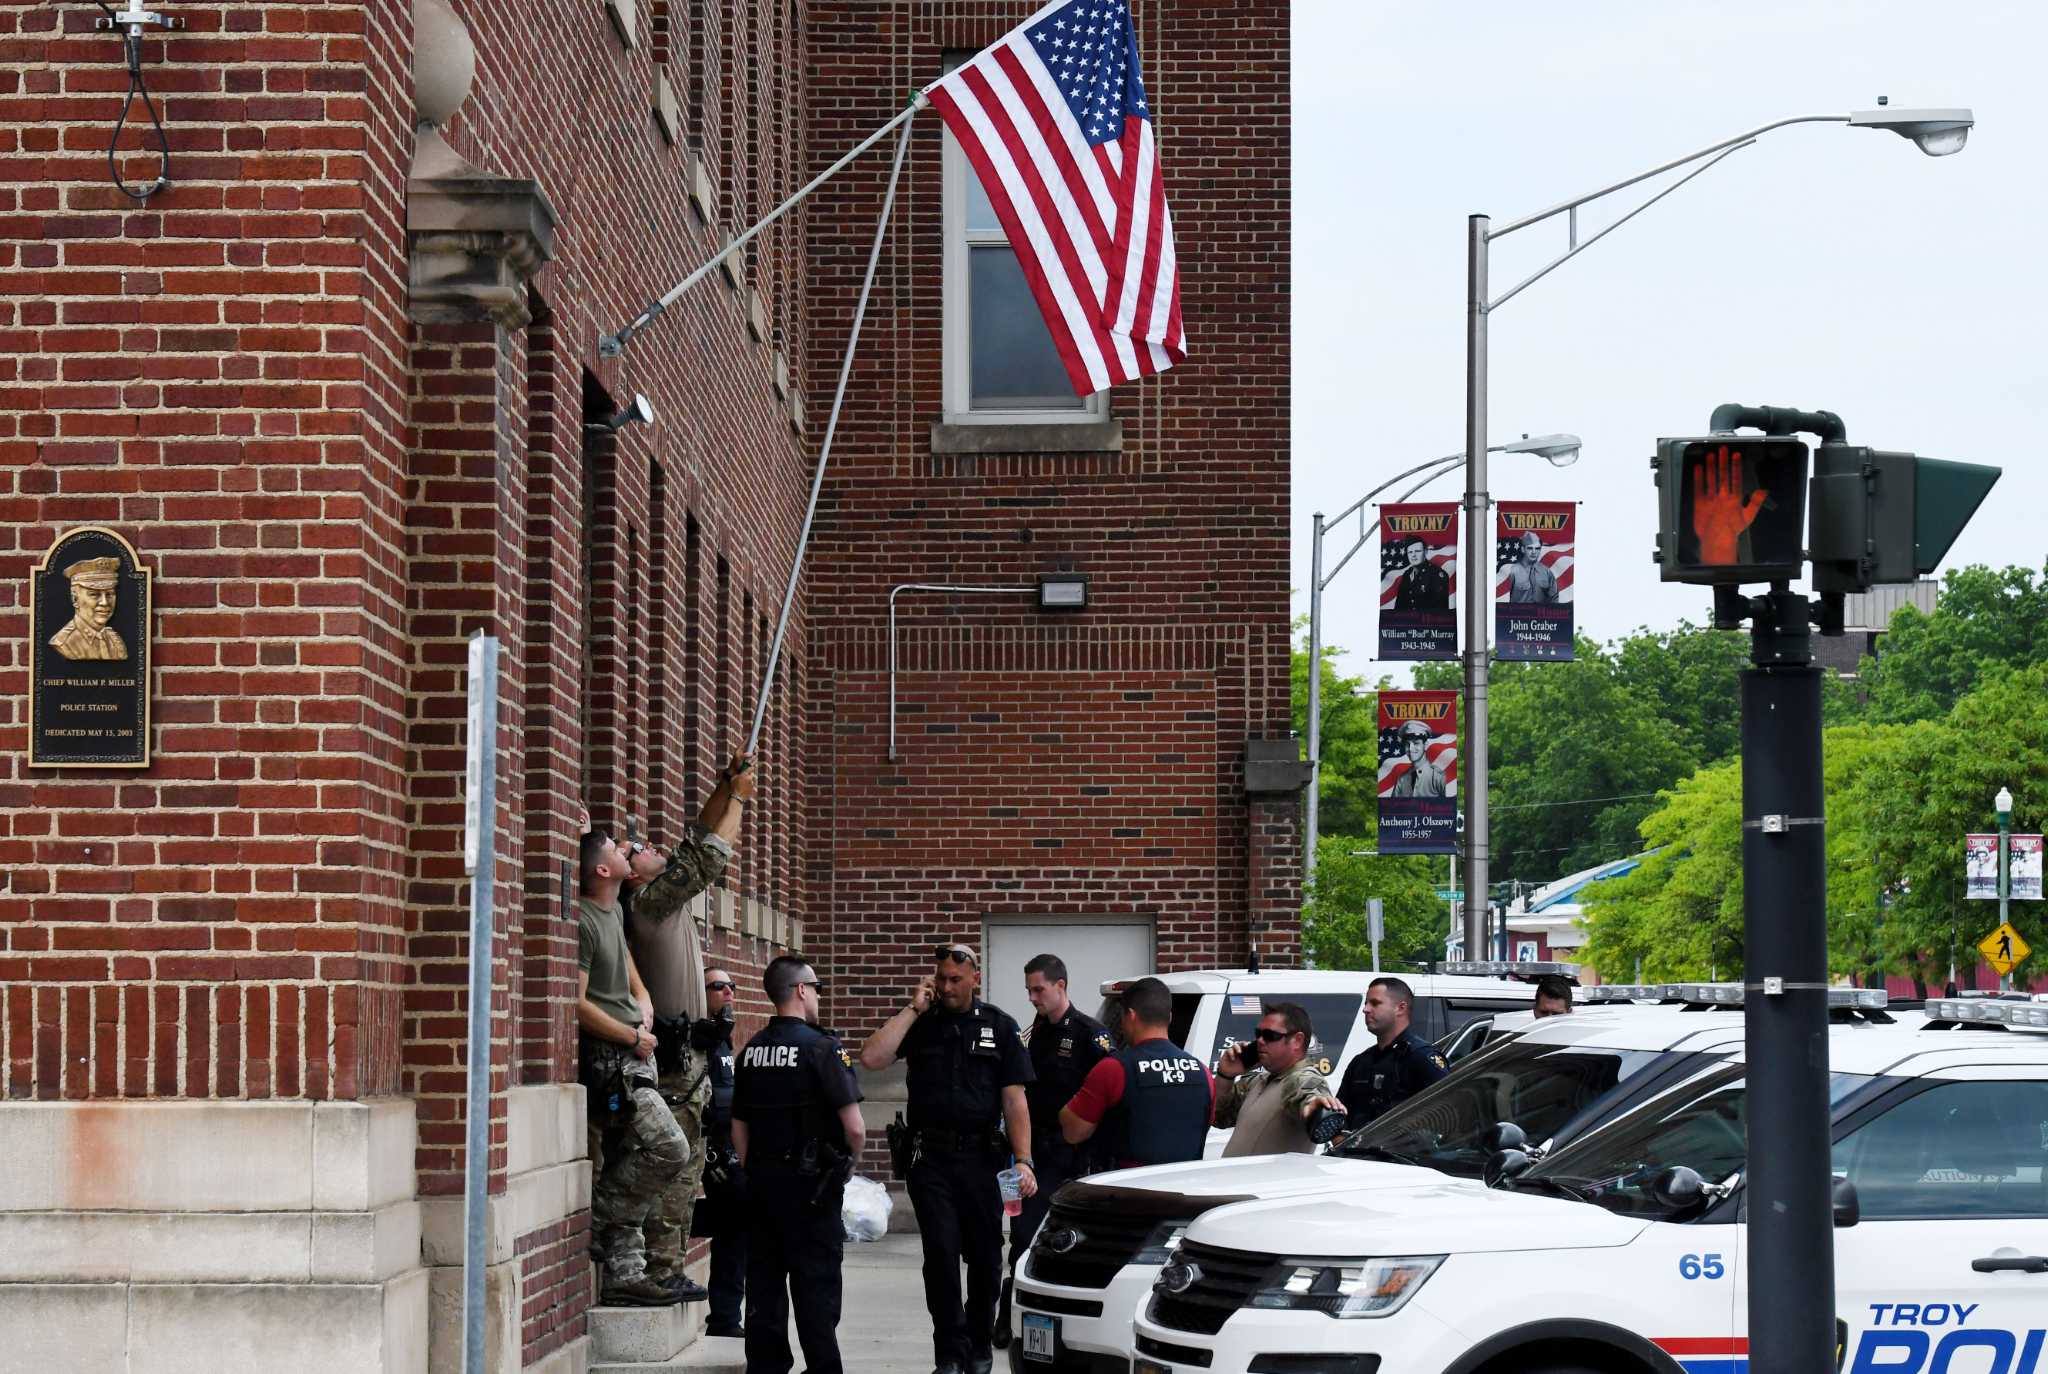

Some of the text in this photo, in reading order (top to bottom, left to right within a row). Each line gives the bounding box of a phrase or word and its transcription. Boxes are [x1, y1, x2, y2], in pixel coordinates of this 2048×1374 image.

[1509, 619, 1558, 633] John Graber
[1381, 628, 1407, 638] William
[1430, 628, 1455, 640] Murray
[1516, 632, 1551, 641] 1944-1946
[43, 679, 65, 687] CHIEF
[67, 679, 98, 687] WILLIAM
[108, 679, 135, 687] MILLER
[60, 703, 118, 712] POLICE STATION
[45, 729, 86, 737] DEDICATED
[88, 729, 103, 737] MAY
[1380, 815, 1454, 829] Anthony J. Olszowy
[743, 1045, 799, 1068] POLICE
[1138, 1058, 1200, 1073] POLICE
[1162, 1070, 1185, 1083] K-9
[1679, 1253, 1724, 1280] 65
[1869, 1303, 1980, 1326] TROY
